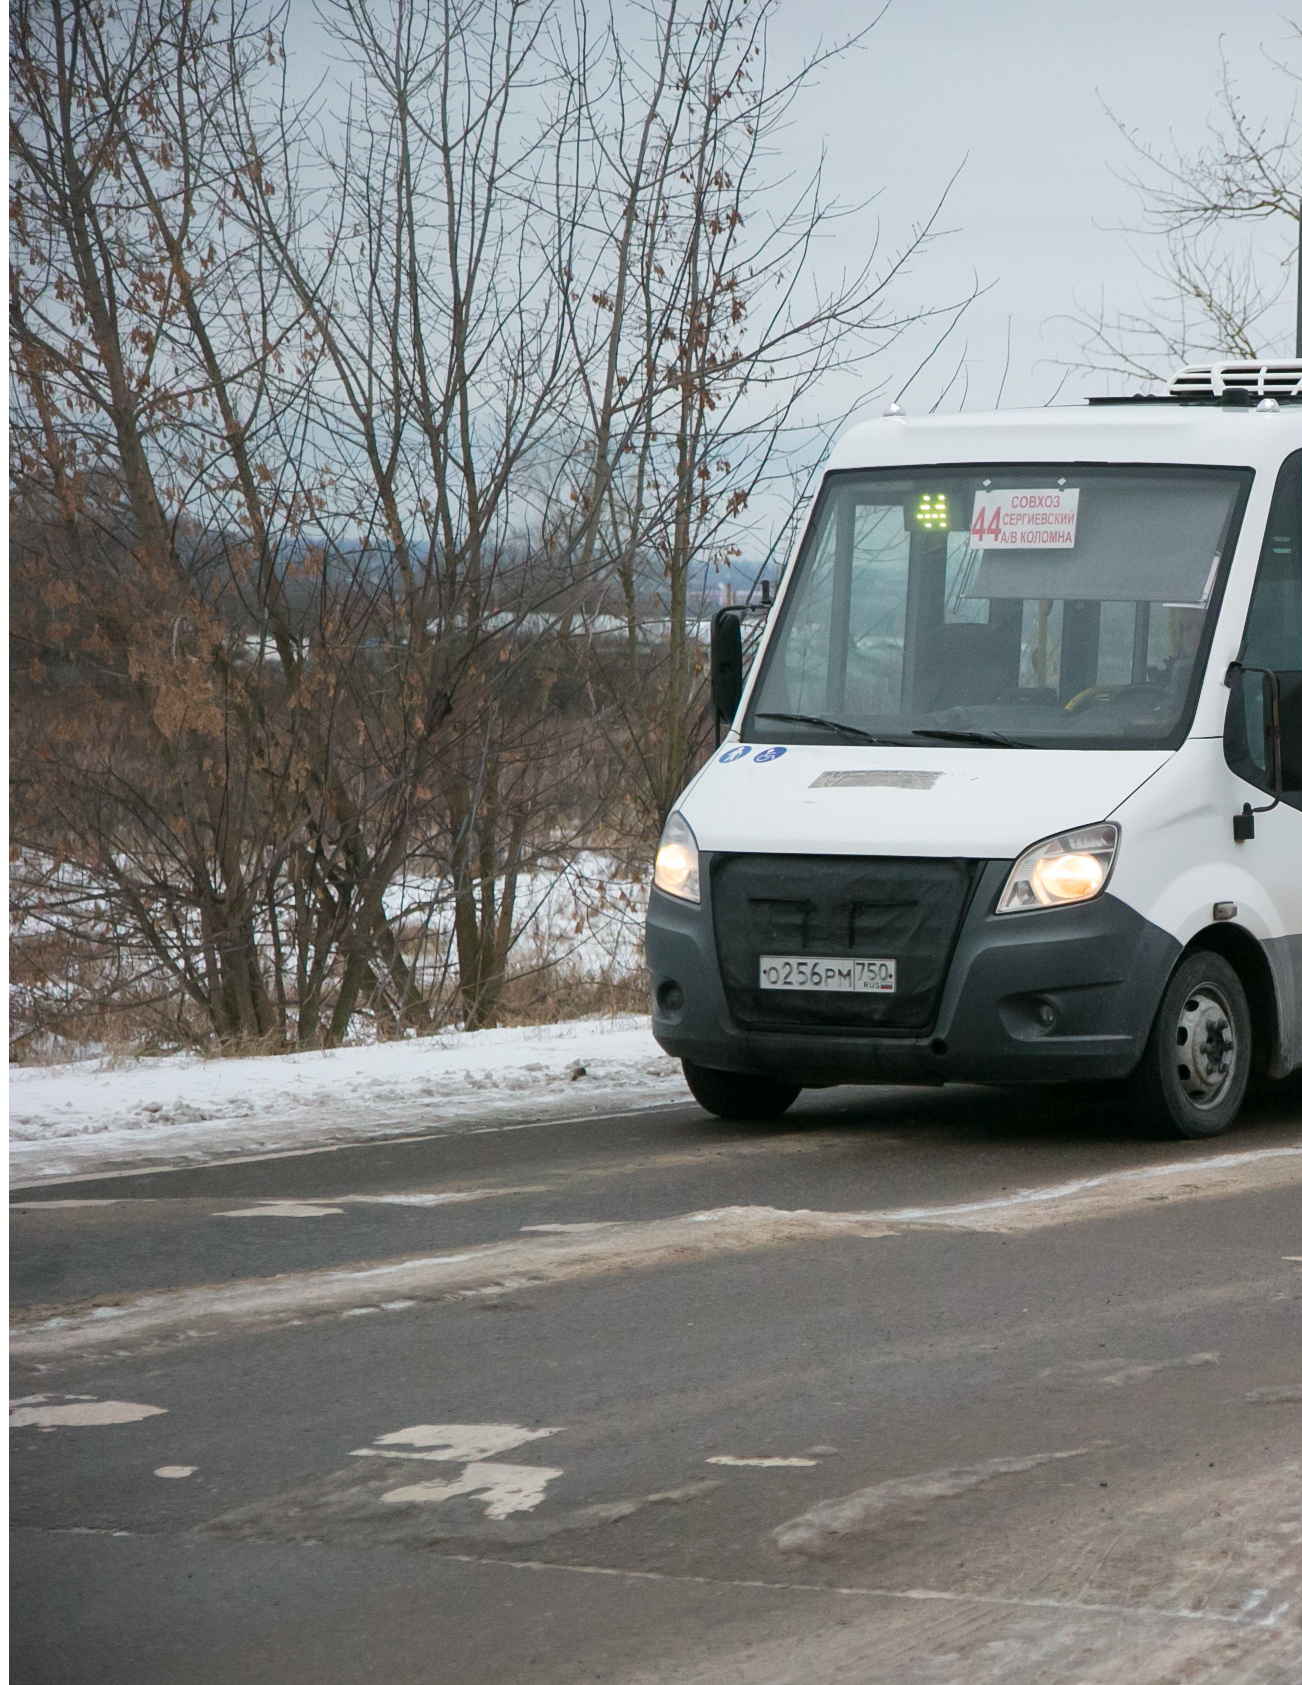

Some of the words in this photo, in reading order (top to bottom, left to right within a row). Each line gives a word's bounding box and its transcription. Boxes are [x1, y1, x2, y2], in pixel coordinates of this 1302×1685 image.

[1011, 495, 1061, 508] СОВХОЗ
[971, 506, 1002, 542] 44
[1002, 510, 1075, 526] СЕРГИЕВСКИЙ
[1000, 531, 1018, 543] А/В
[1020, 530, 1072, 543] КОЛОМНА
[855, 962, 888, 981] 750
